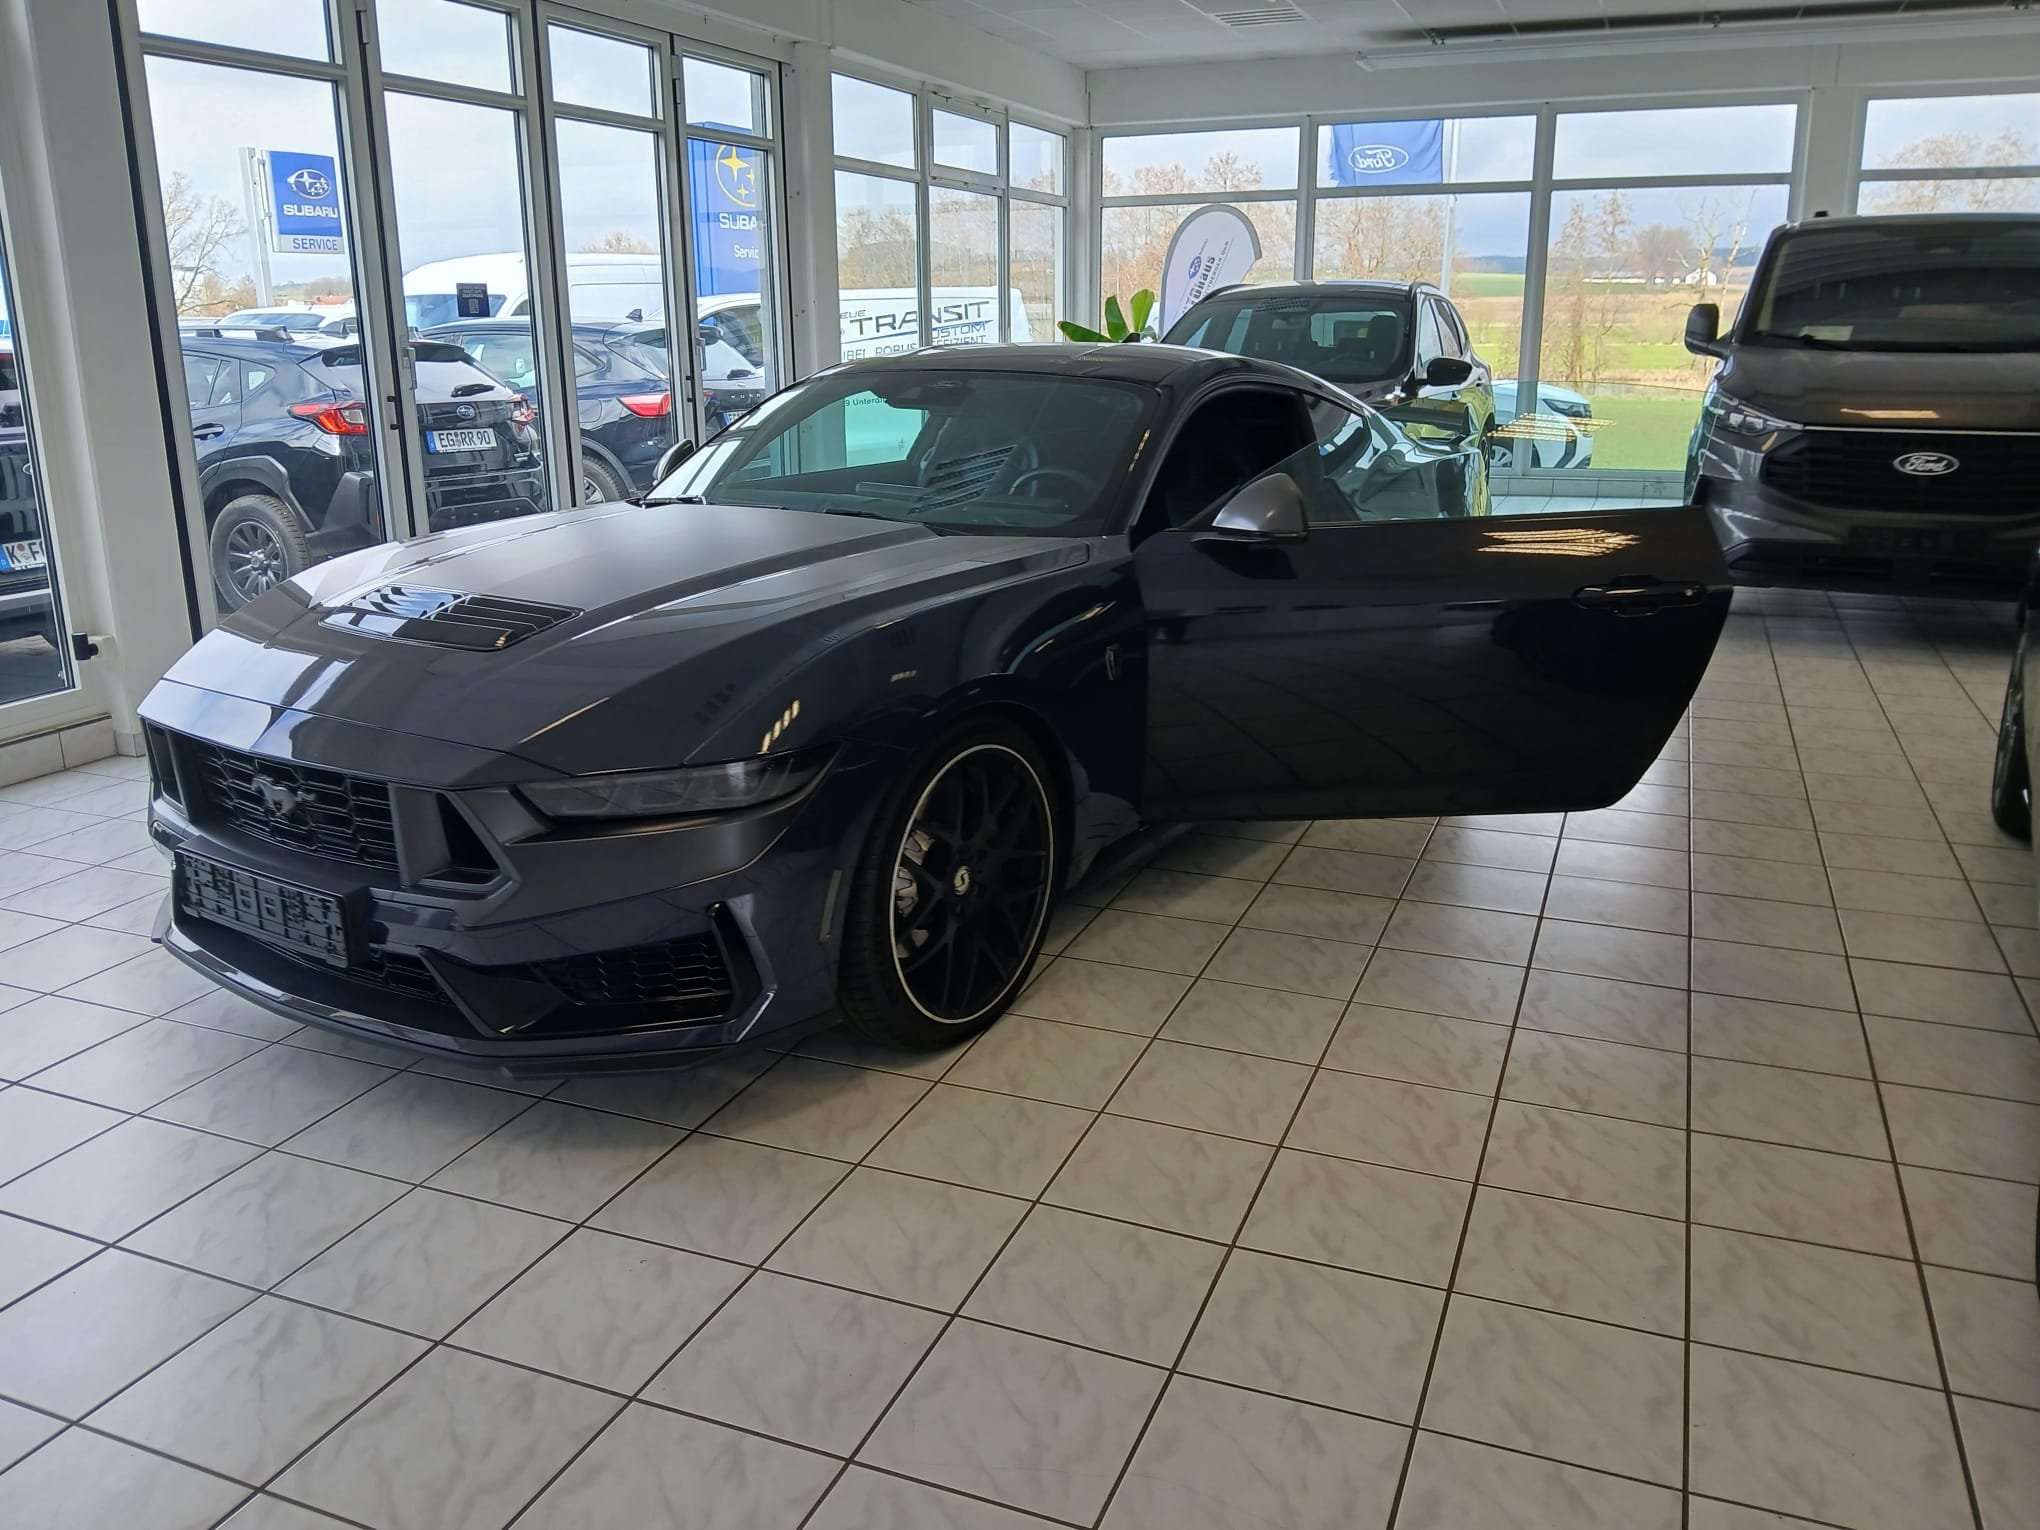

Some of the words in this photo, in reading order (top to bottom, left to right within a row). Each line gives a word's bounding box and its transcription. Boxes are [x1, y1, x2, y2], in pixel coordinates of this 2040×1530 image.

[283, 204, 338, 218] SUBARU
[719, 212, 758, 231] SUBA
[292, 238, 338, 250] SERVICE
[734, 244, 759, 259] Servic
[840, 309, 866, 320] EUE
[931, 320, 987, 339] USTOM
[438, 432, 456, 448] EG
[460, 431, 477, 446] RR
[477, 430, 491, 445] 90
